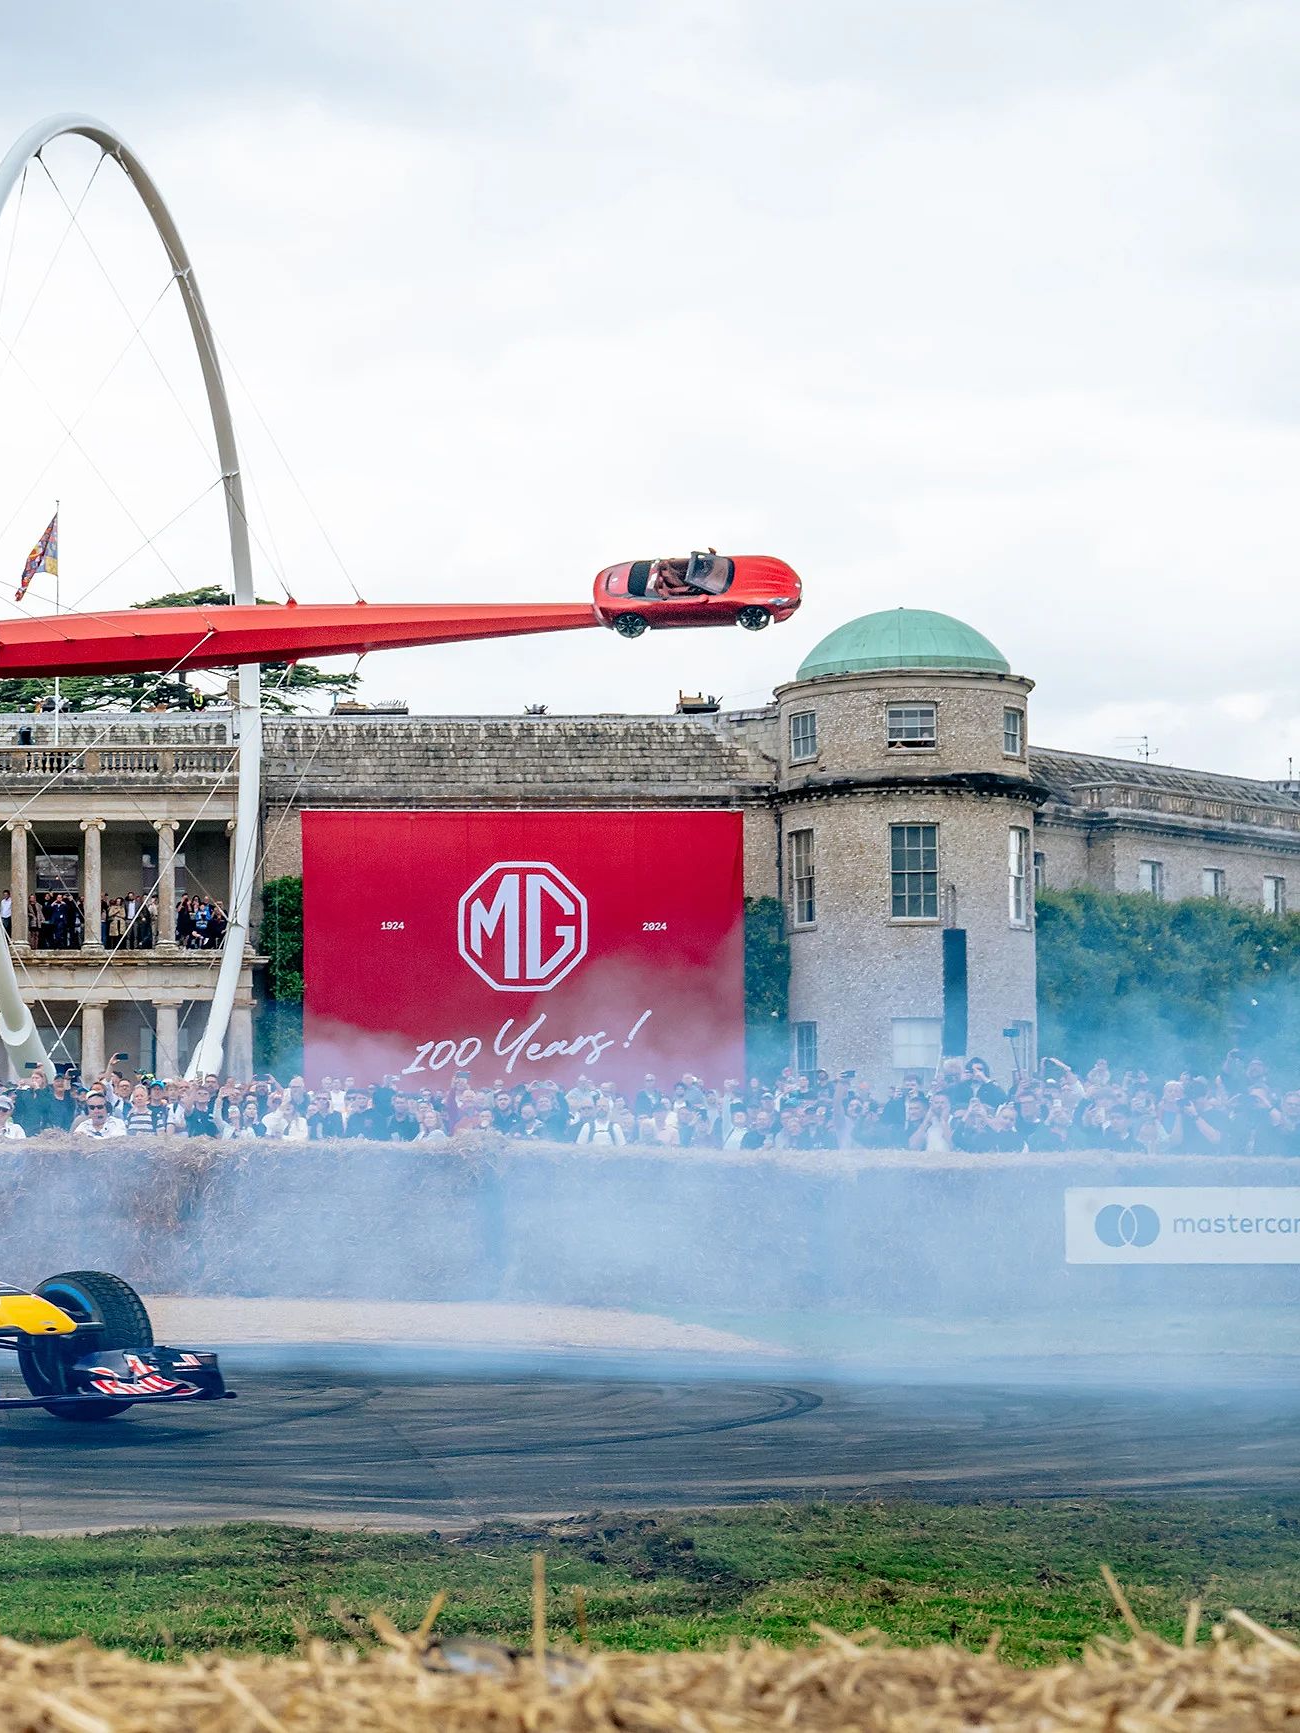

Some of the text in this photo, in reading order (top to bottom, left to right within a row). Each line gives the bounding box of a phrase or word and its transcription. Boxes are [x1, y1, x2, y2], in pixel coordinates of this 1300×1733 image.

[381, 921, 405, 931] 1924
[470, 873, 576, 980] MG
[642, 921, 668, 931] 2024
[401, 1036, 483, 1075] 100
